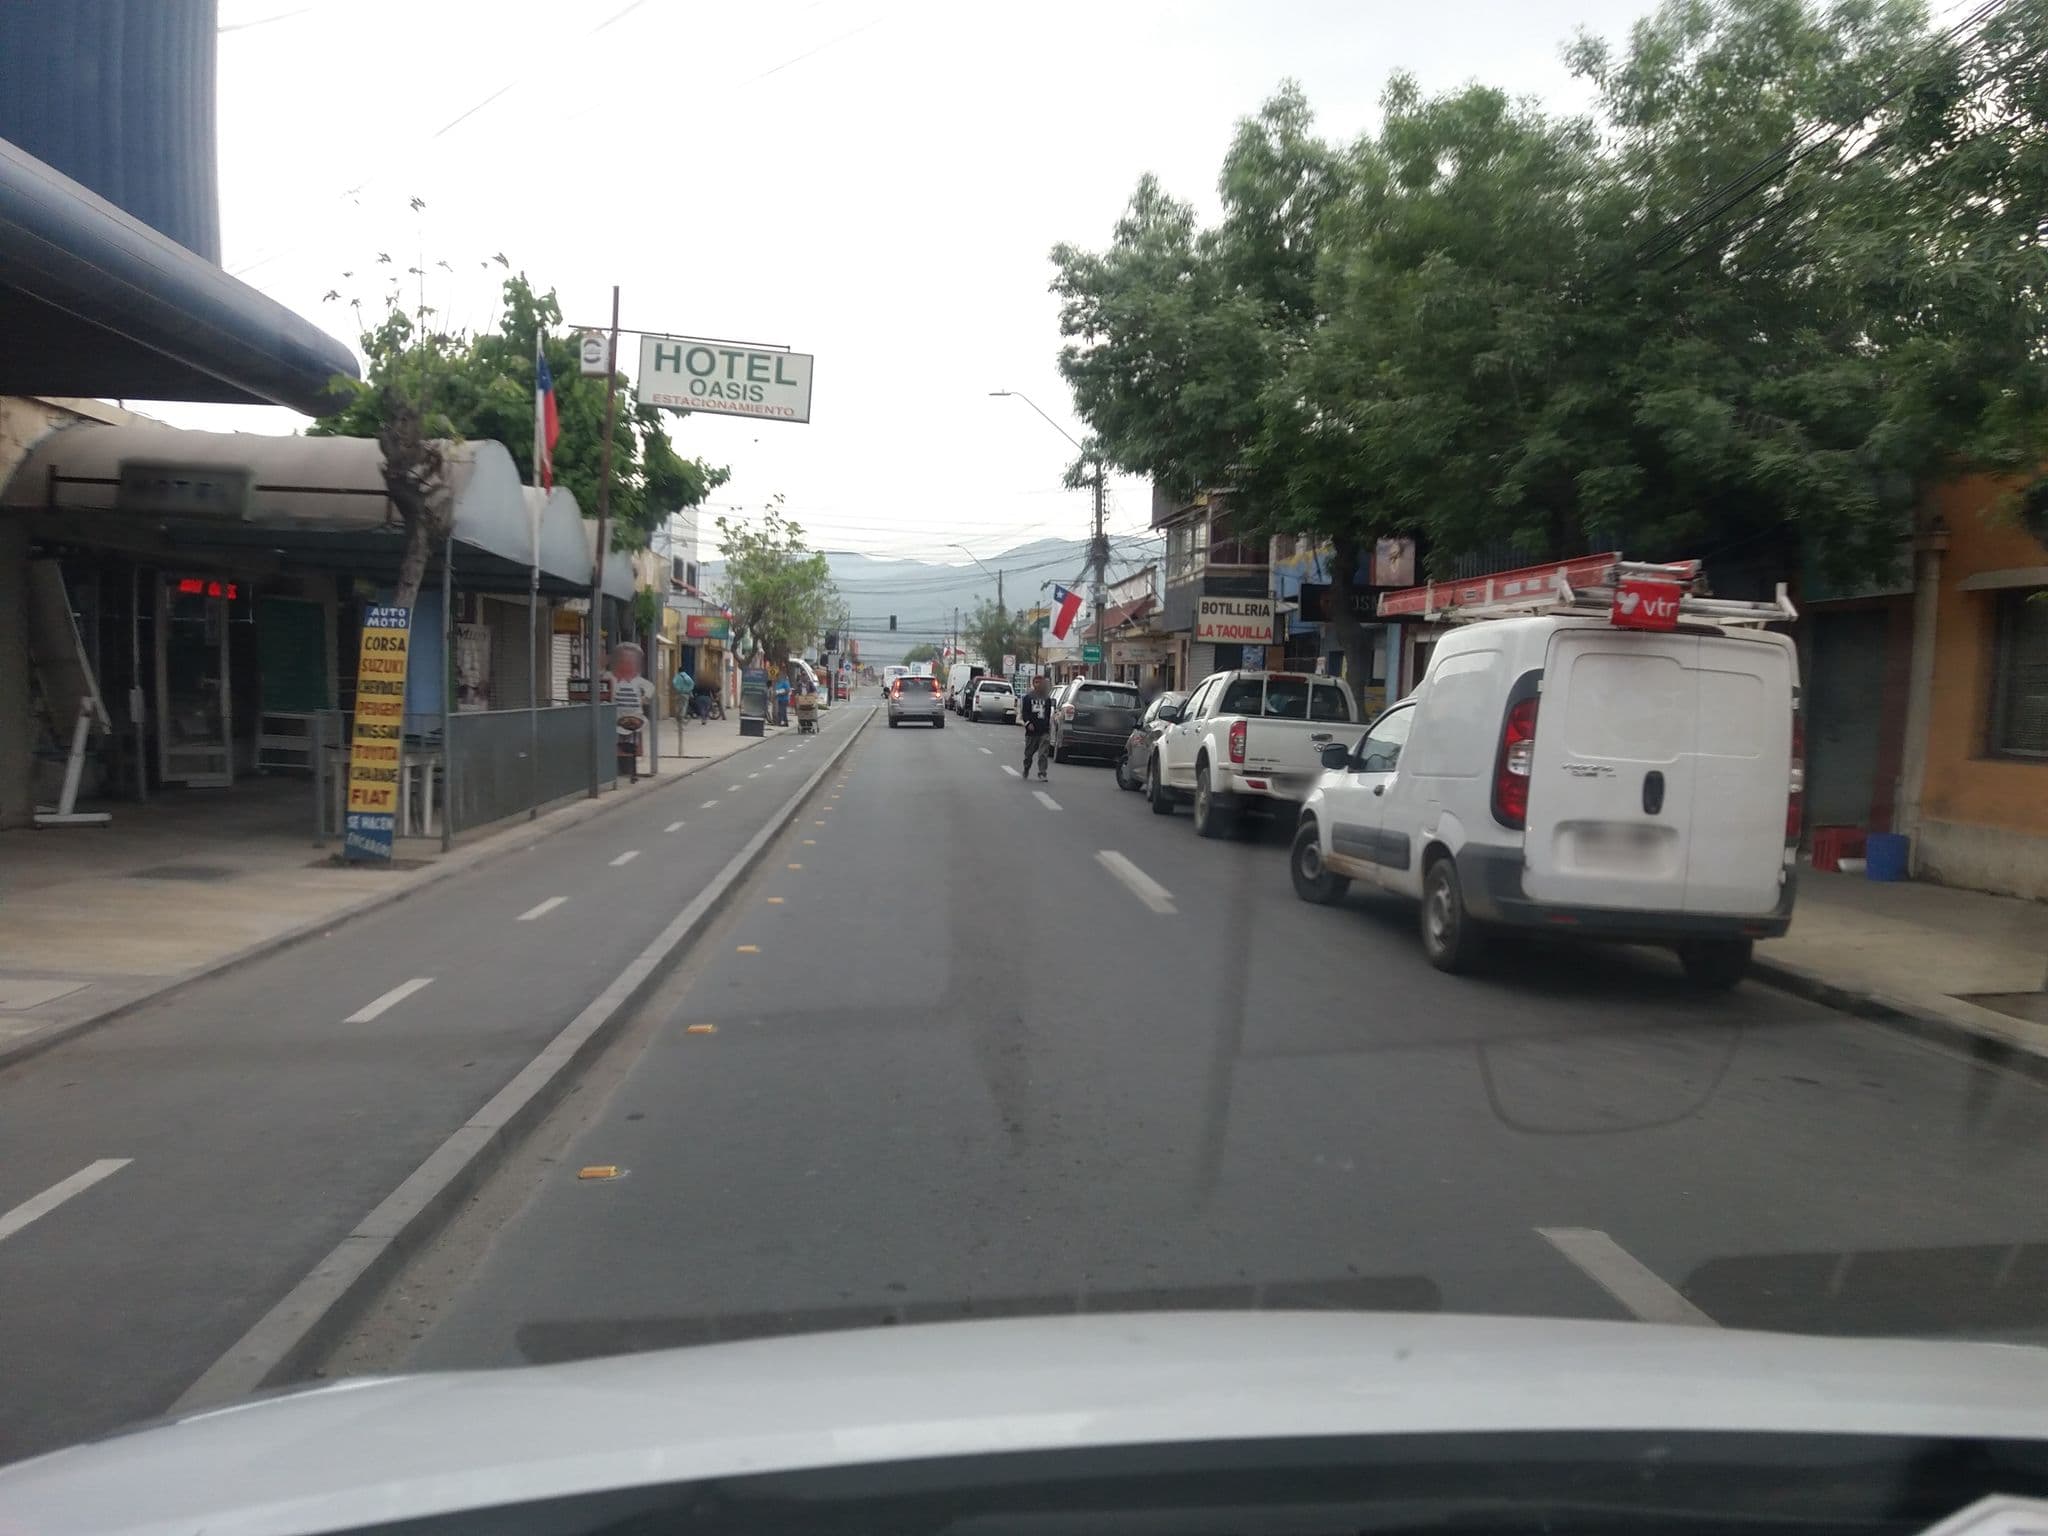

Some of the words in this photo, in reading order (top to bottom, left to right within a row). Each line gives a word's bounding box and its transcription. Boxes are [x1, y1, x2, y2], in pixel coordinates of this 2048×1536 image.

[654, 343, 797, 386] HOTEL
[689, 379, 764, 402] OASIS
[653, 393, 795, 417] ESTACIONAMIENTO
[371, 608, 406, 617] AUTO
[1201, 601, 1270, 617] BOTILLERIA
[1642, 597, 1677, 617] vtr
[367, 618, 406, 628] MOTO
[1198, 623, 1213, 638] LA
[1217, 624, 1272, 640] TAQUILLA
[365, 637, 406, 652] CORSA
[361, 658, 405, 673] SUZUKI
[352, 788, 392, 805] FIAT
